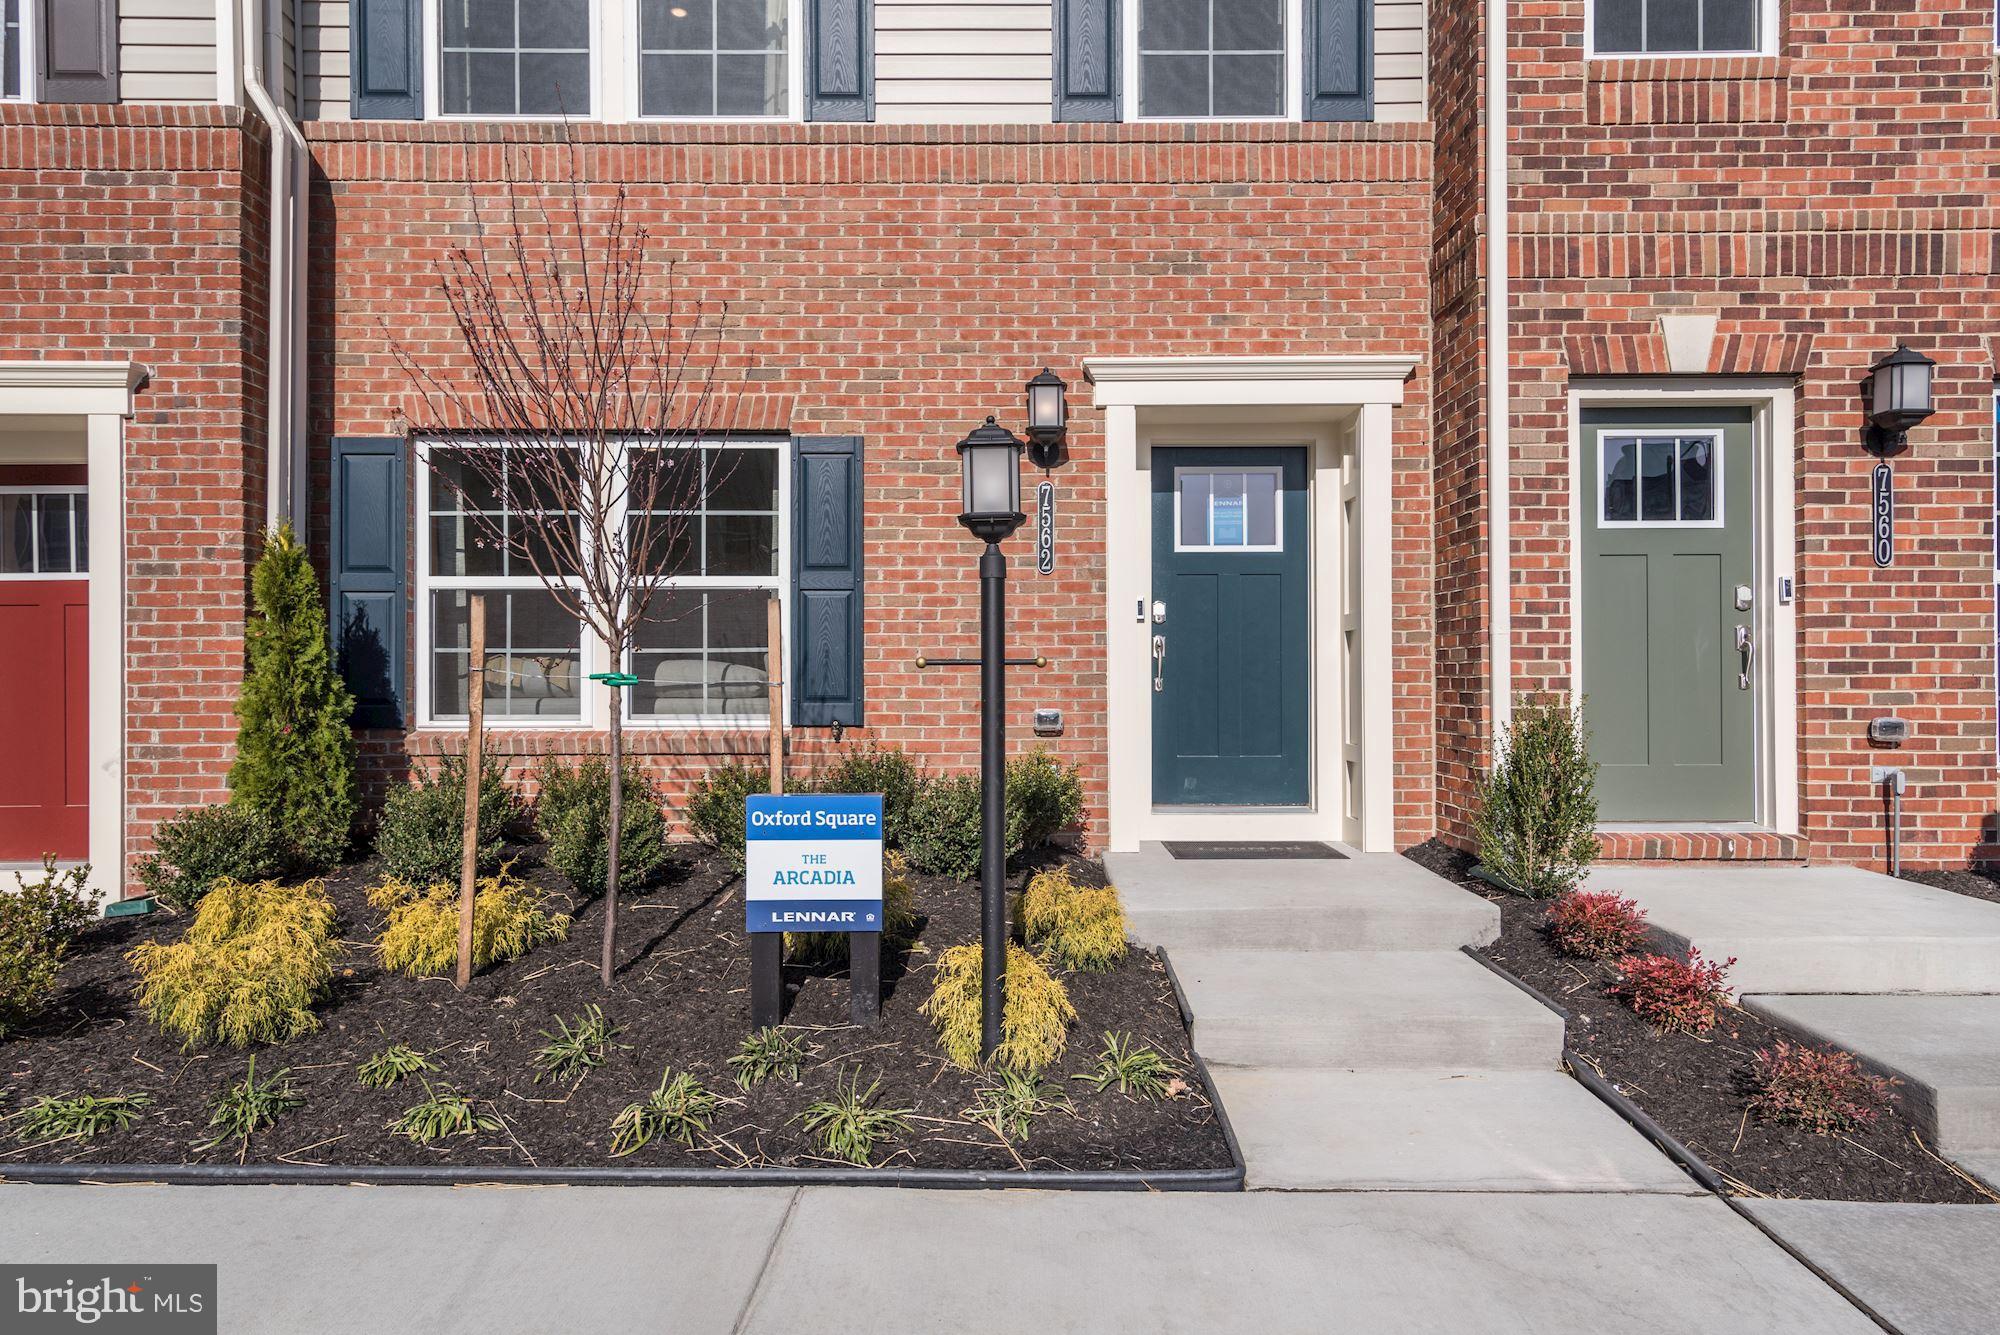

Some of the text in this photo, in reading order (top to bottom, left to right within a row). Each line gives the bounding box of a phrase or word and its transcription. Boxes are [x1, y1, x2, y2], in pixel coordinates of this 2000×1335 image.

[1878, 468, 1890, 562] 7560
[1041, 485, 1051, 570] 7562
[751, 811, 877, 829] Oxford Square
[801, 854, 827, 864] THE
[773, 871, 855, 885] ARCADIA
[772, 912, 855, 922] LENNAR
